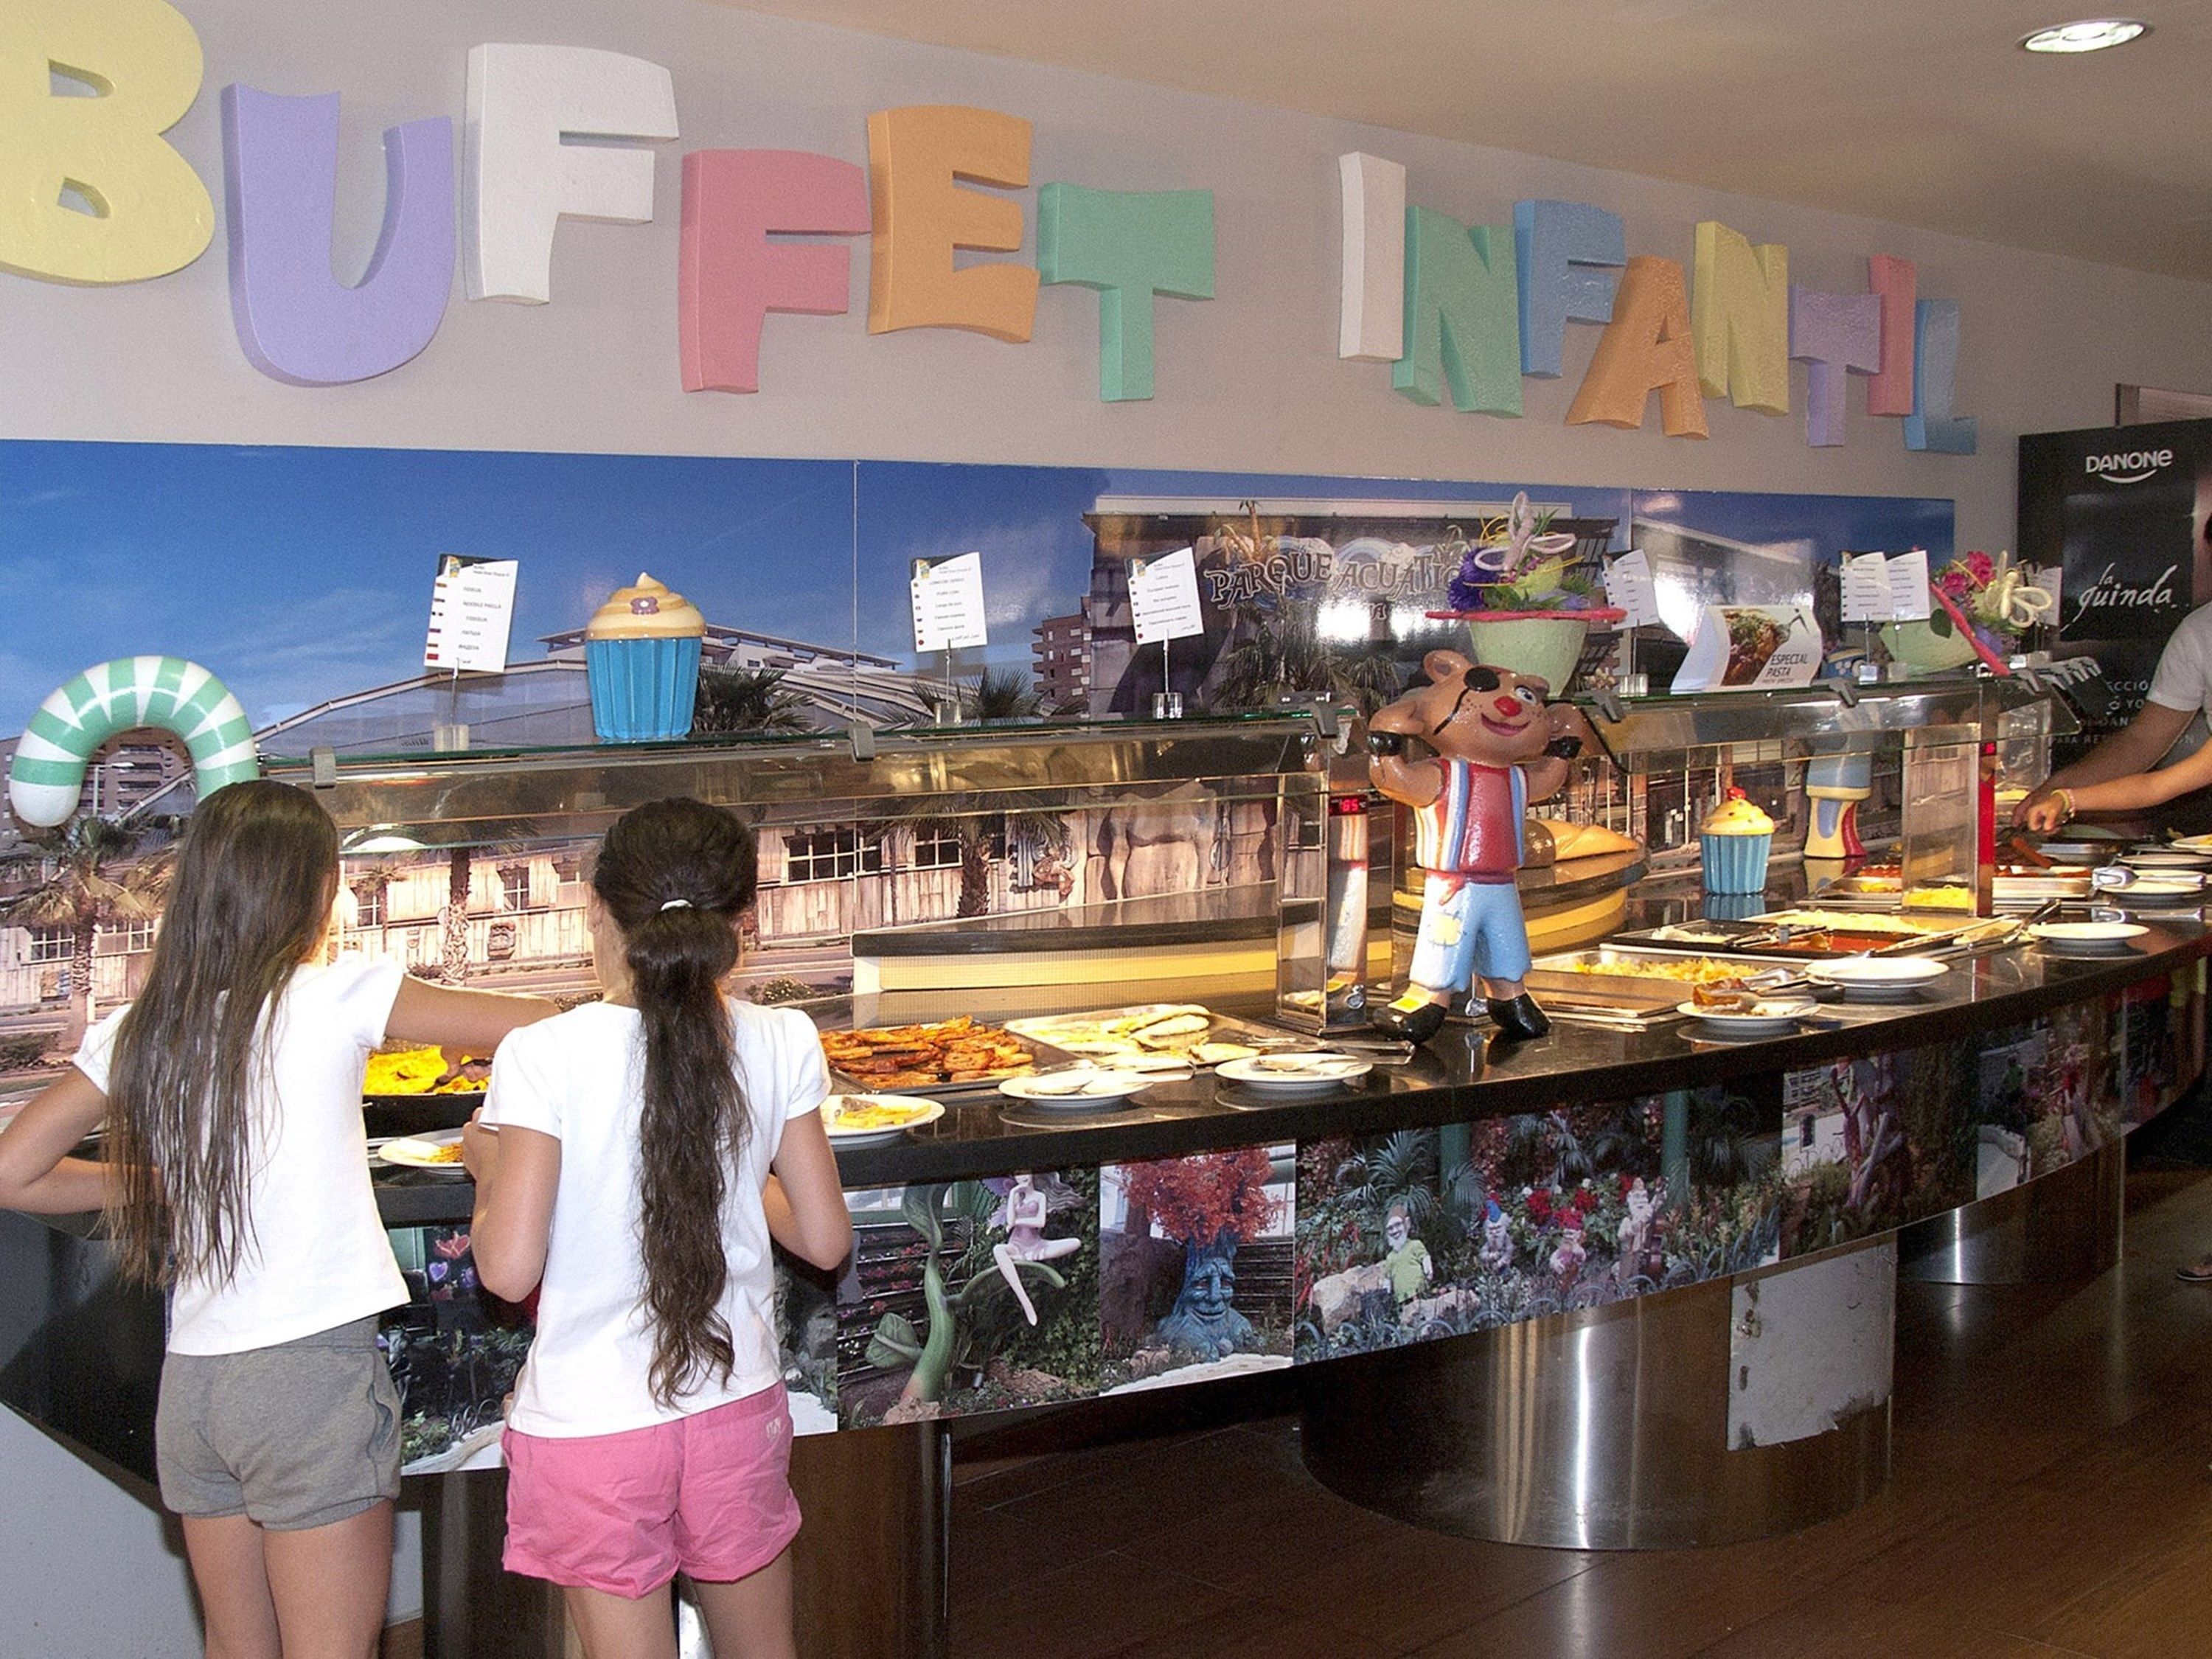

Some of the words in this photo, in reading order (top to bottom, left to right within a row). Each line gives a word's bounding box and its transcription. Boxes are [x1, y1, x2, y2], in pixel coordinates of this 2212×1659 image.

[0, 0, 1215, 402] BUFFET
[1338, 151, 1978, 455] INFANTIL
[1205, 553, 1333, 611] PARQUE
[1336, 553, 1459, 602] ACUATIC
[2099, 563, 2116, 585] la
[1770, 653, 1809, 666] ESPECIAL
[1766, 667, 1791, 678] PASTA
